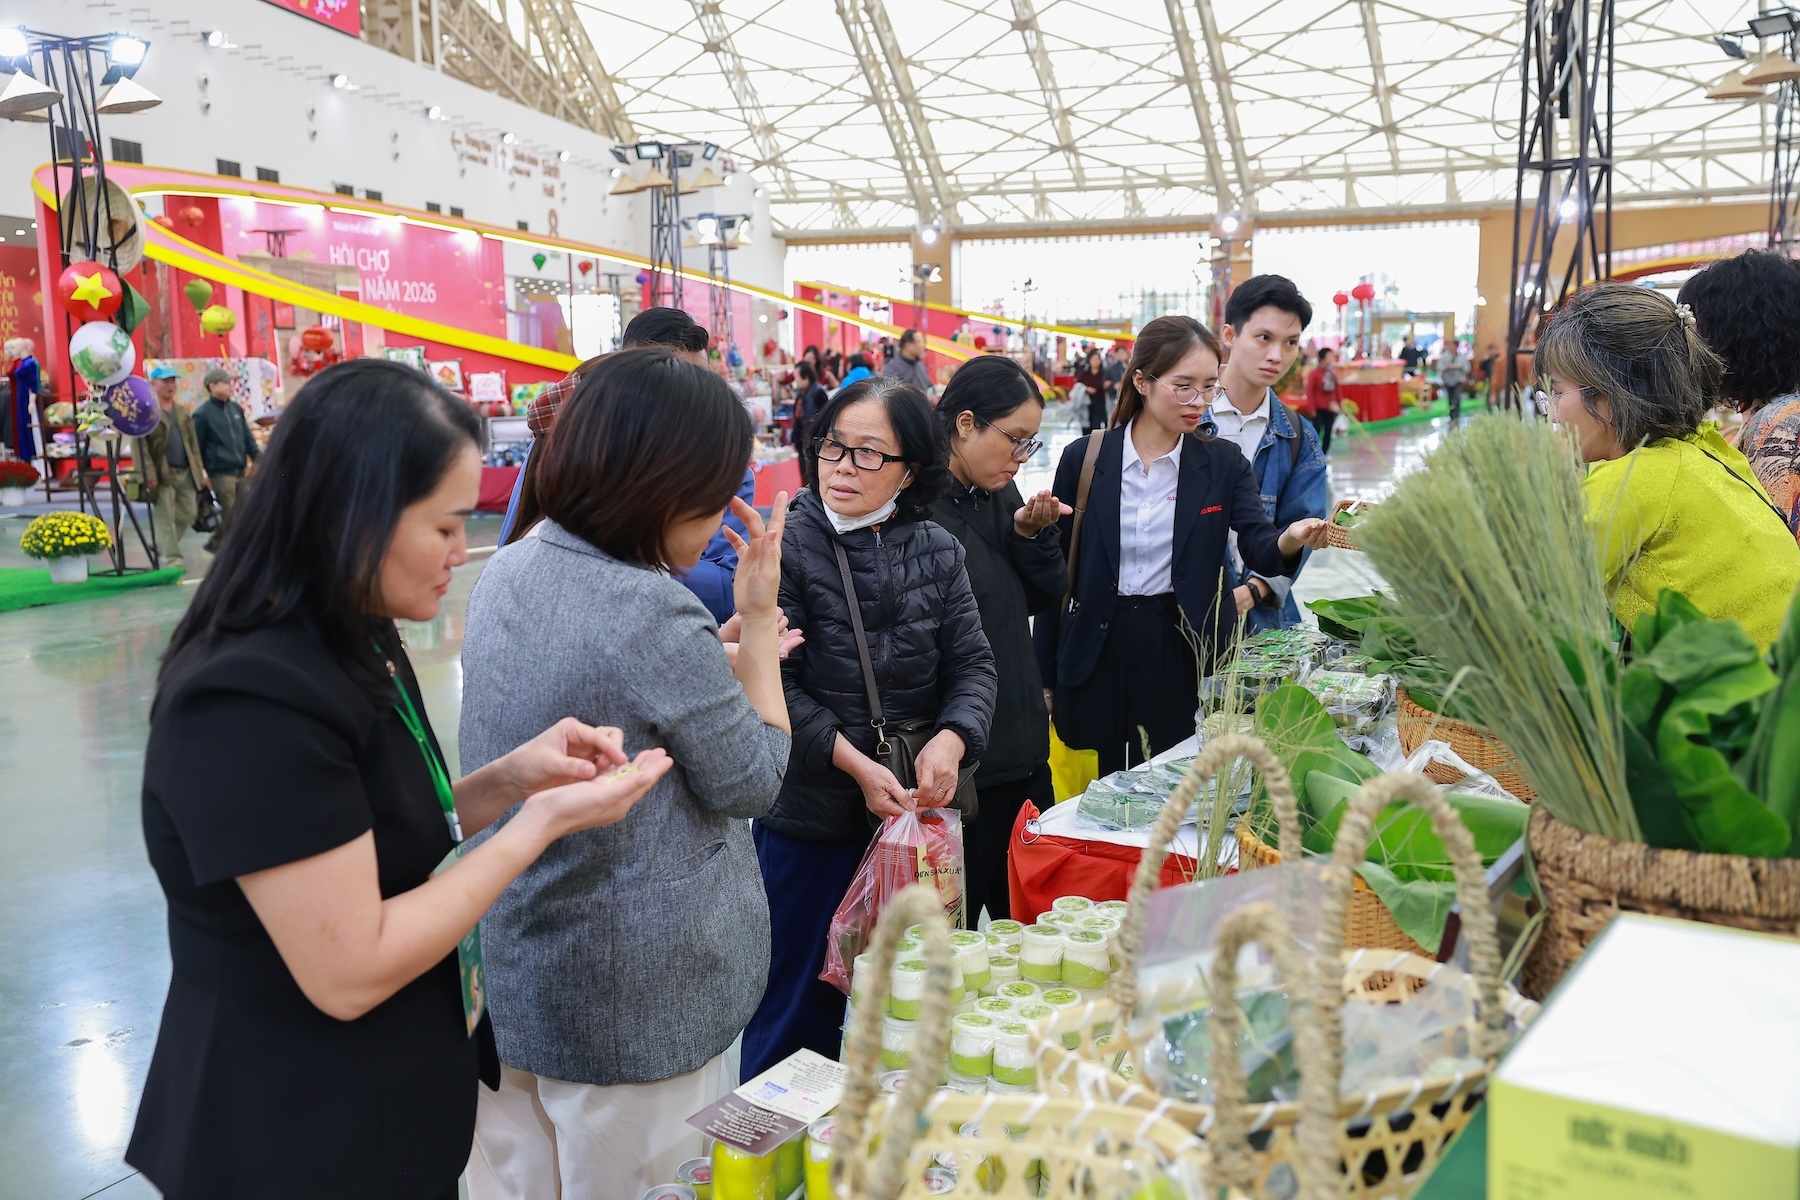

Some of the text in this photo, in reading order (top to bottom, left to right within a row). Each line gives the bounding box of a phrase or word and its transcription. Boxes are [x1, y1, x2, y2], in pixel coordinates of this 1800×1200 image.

[357, 247, 391, 277] CHỢ
[365, 276, 437, 303] NĂM 2026
